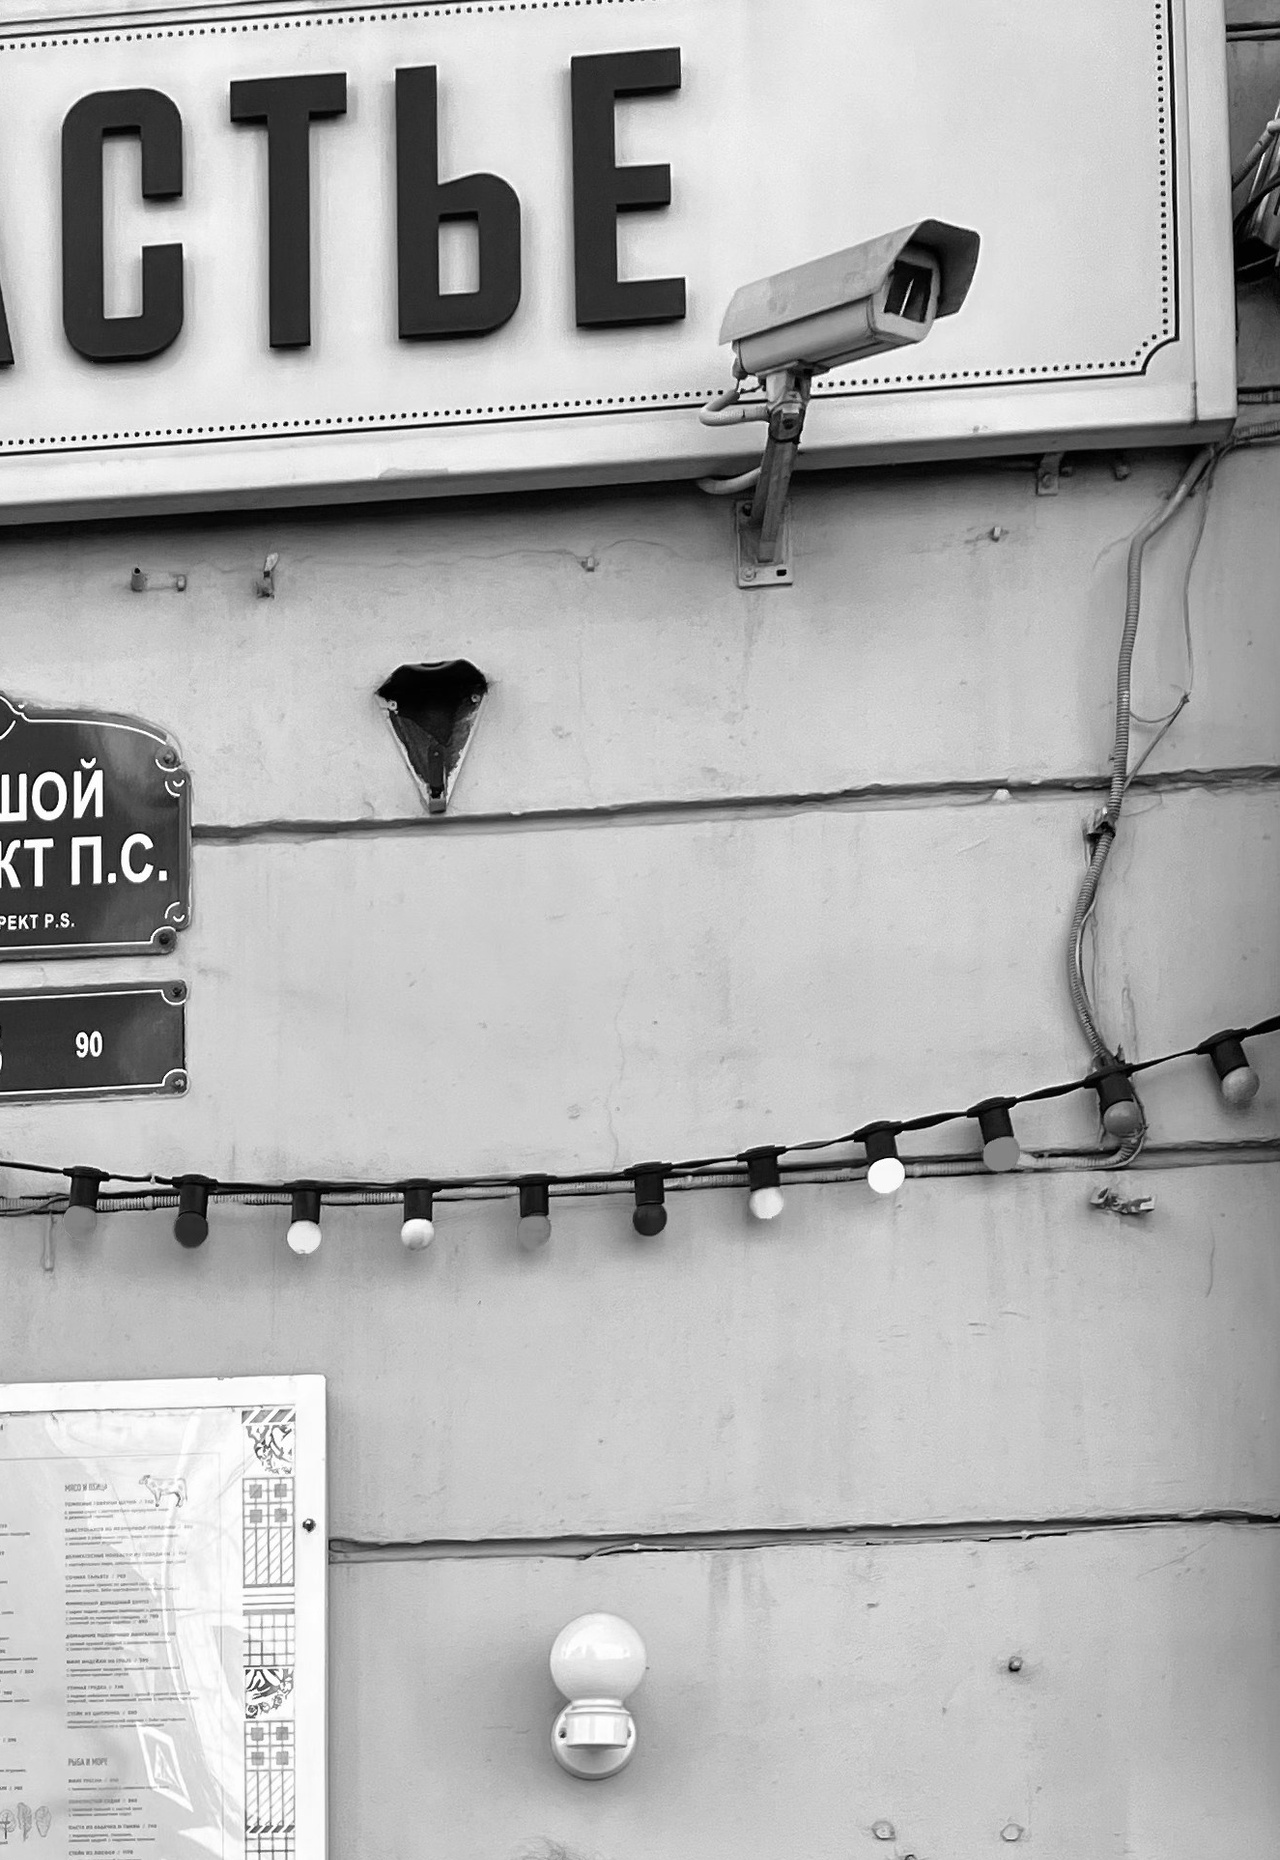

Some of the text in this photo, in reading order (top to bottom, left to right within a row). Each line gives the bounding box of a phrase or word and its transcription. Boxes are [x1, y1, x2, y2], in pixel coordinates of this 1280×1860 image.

[71, 833, 168, 886] П.С.
[44, 912, 75, 929] P.S.
[75, 1031, 103, 1058] 90
